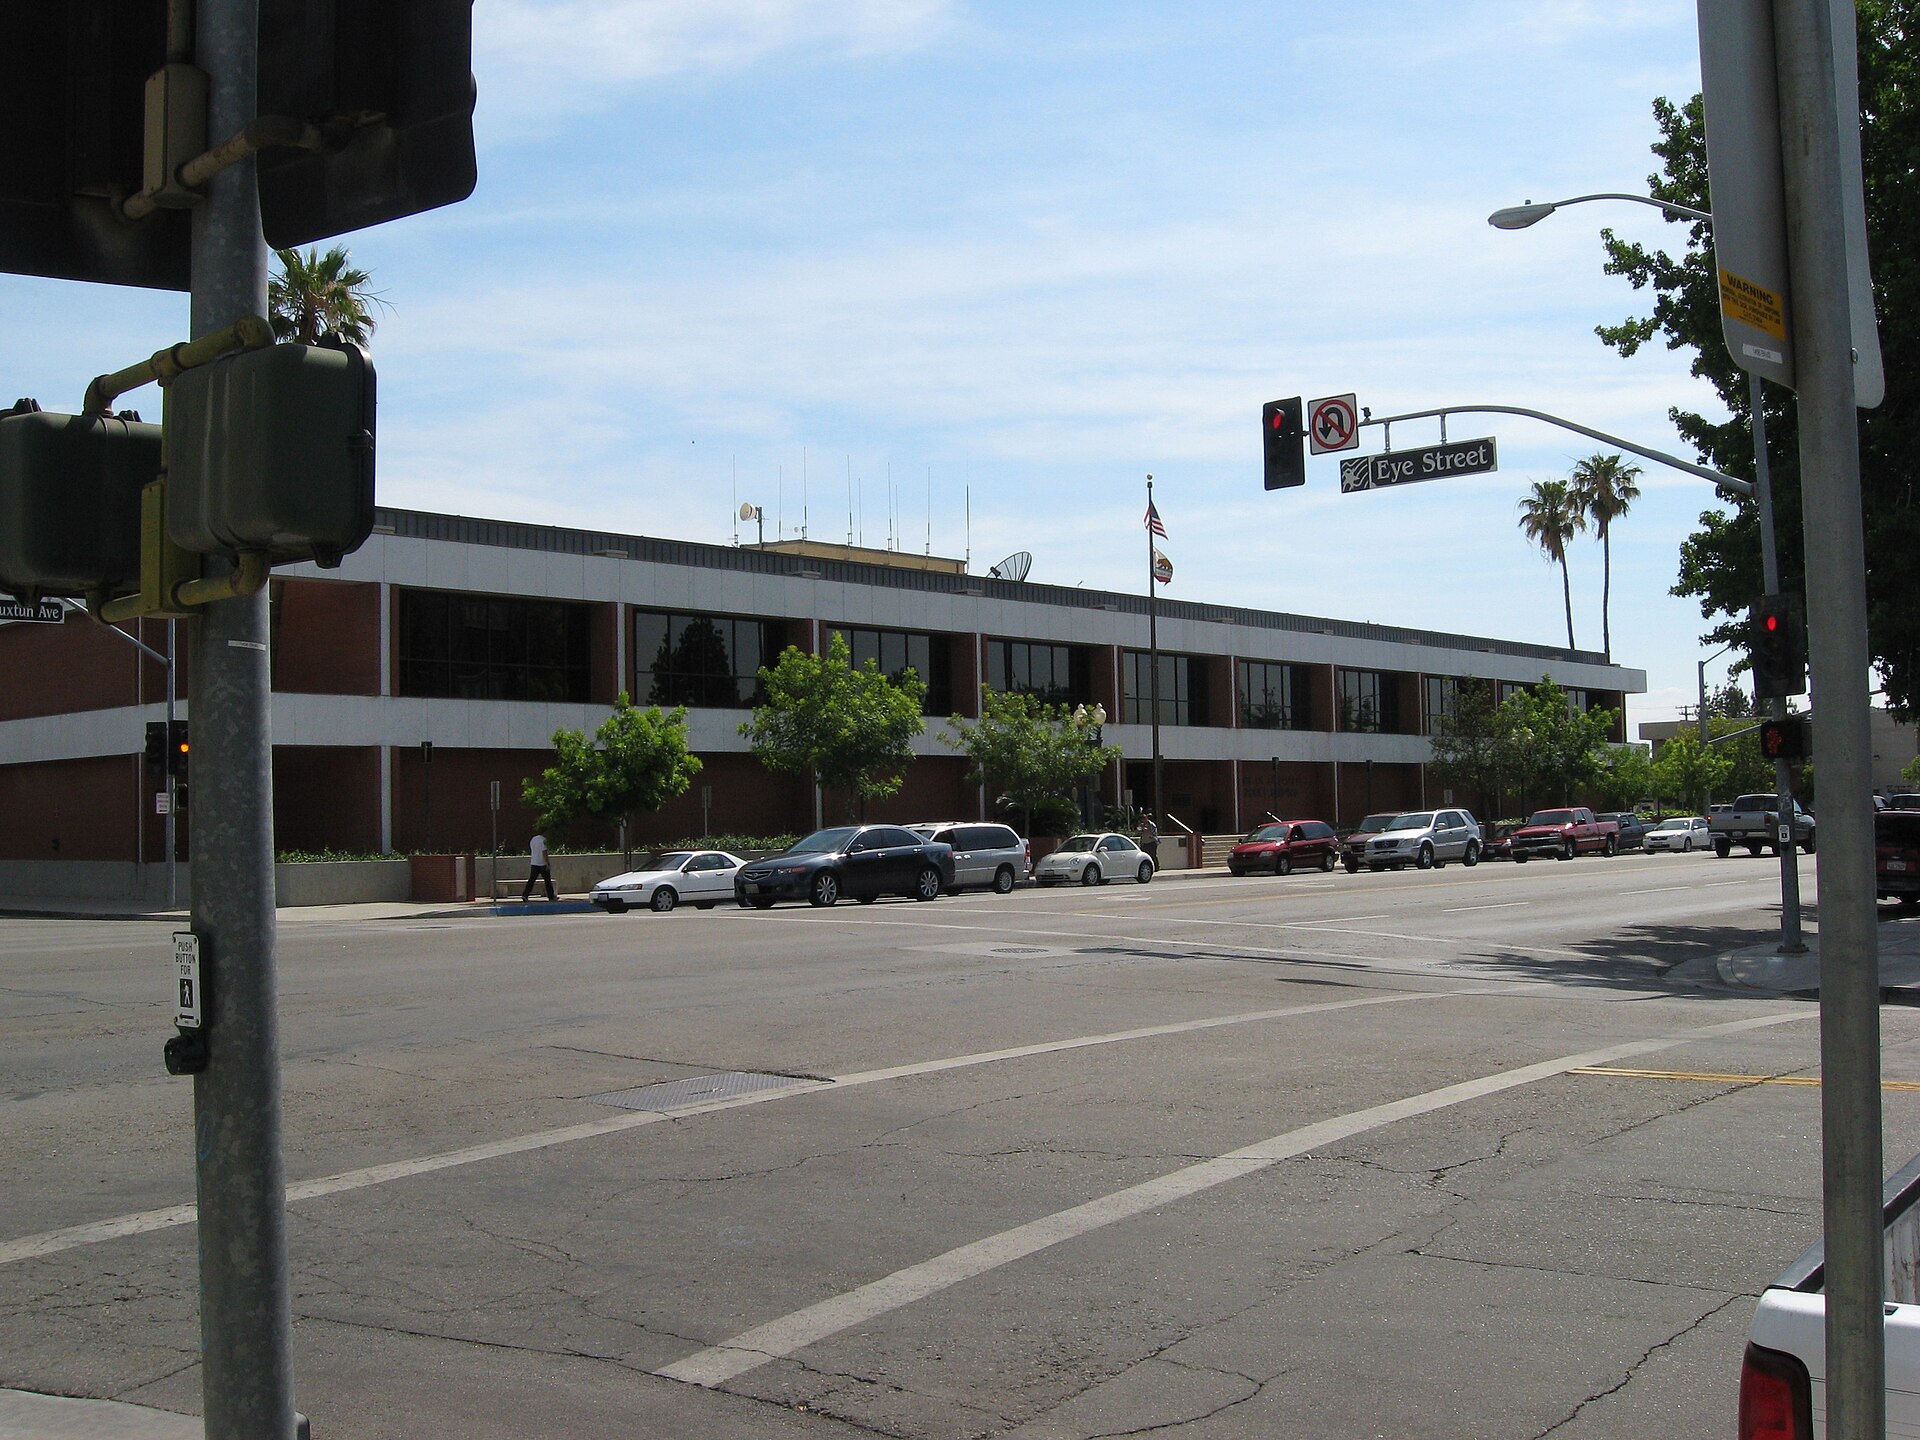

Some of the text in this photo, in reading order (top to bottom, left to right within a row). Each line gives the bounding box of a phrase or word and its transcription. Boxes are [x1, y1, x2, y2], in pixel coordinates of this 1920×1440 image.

[1726, 273, 1774, 306] WARNING
[1376, 444, 1488, 483] Eye Street
[38, 605, 60, 619] Ave
[178, 941, 193, 952] PUSH
[175, 952, 196, 963] BUTTON
[180, 965, 191, 976] FOR
